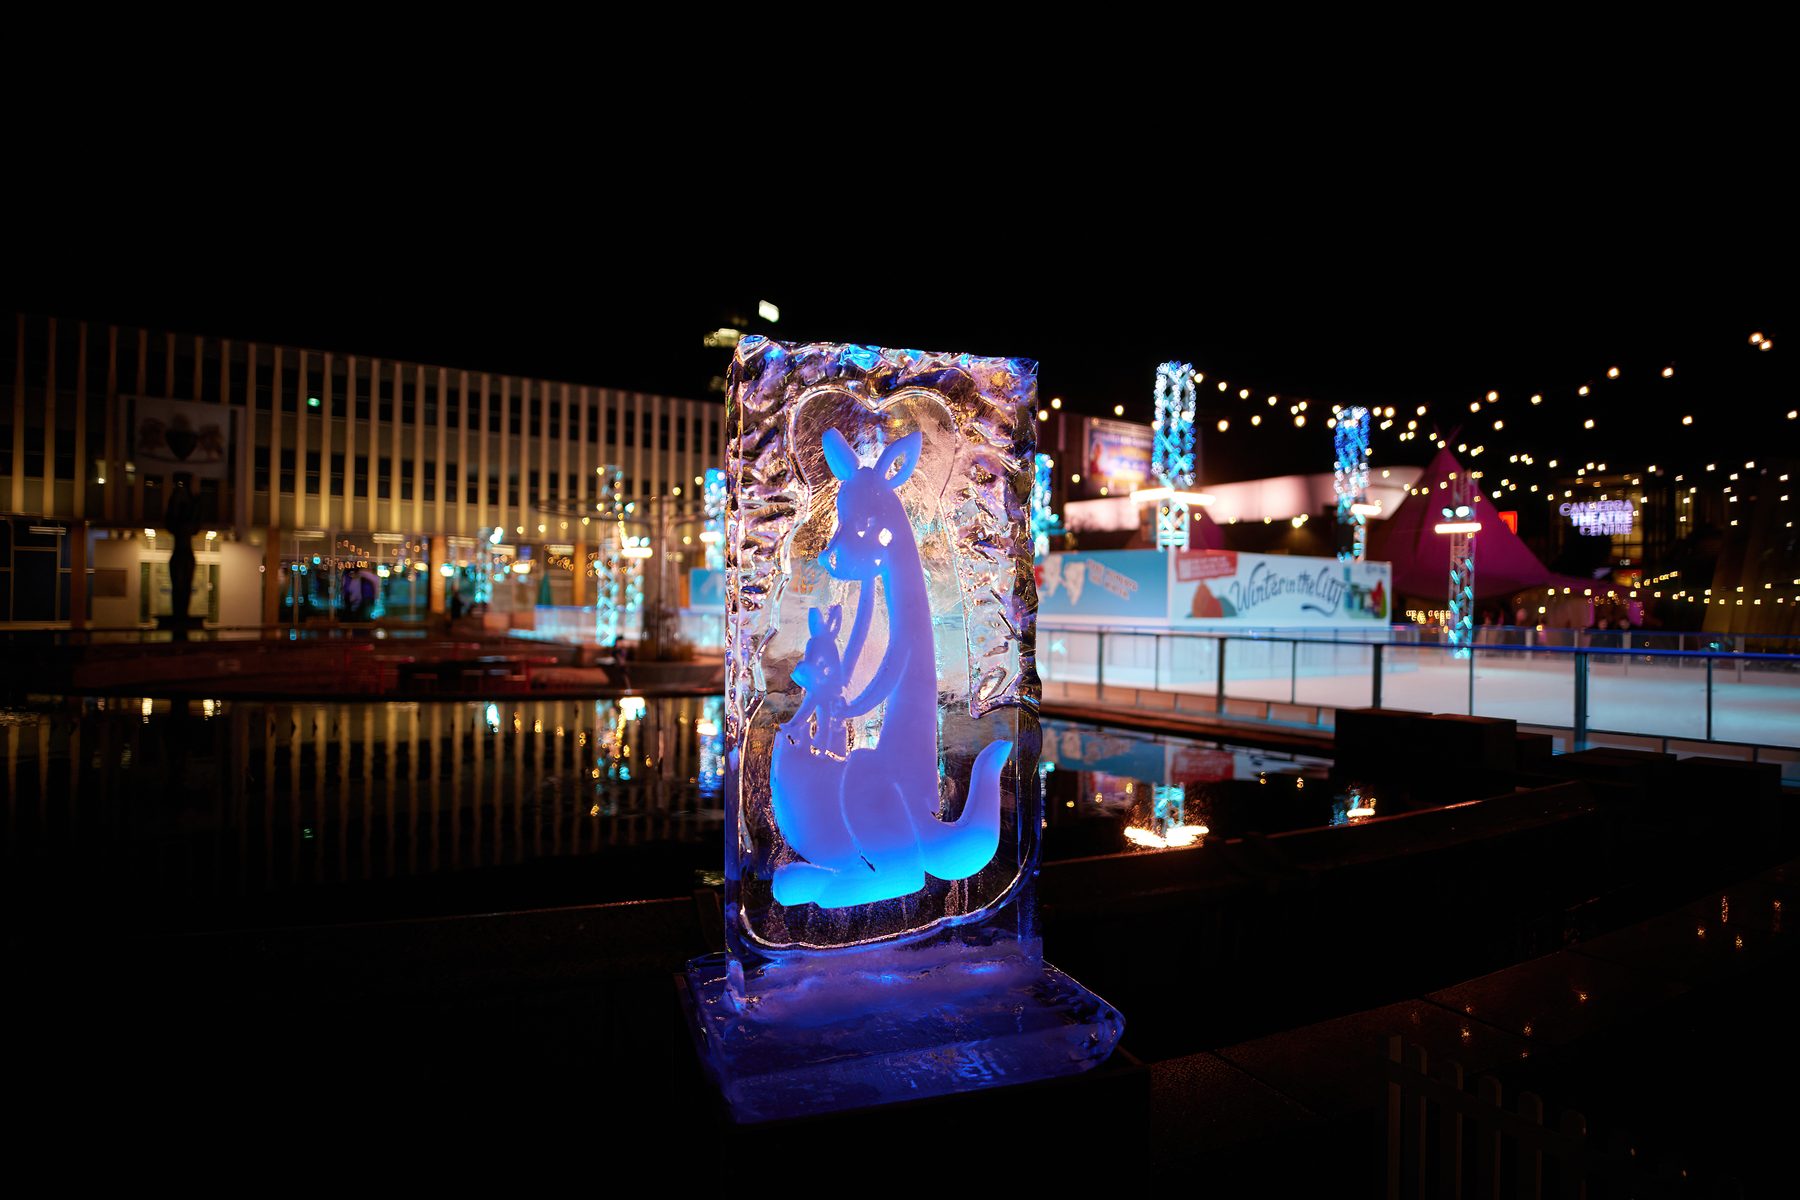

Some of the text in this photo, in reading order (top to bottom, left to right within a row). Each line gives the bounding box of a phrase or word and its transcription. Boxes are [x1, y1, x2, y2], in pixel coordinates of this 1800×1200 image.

[1570, 511, 1633, 527] THEATRE
[1579, 523, 1633, 536] CENTRE
[1229, 561, 1285, 612] Winter
[1285, 576, 1296, 594] in
[1297, 570, 1315, 596] the
[1301, 566, 1347, 617] City
